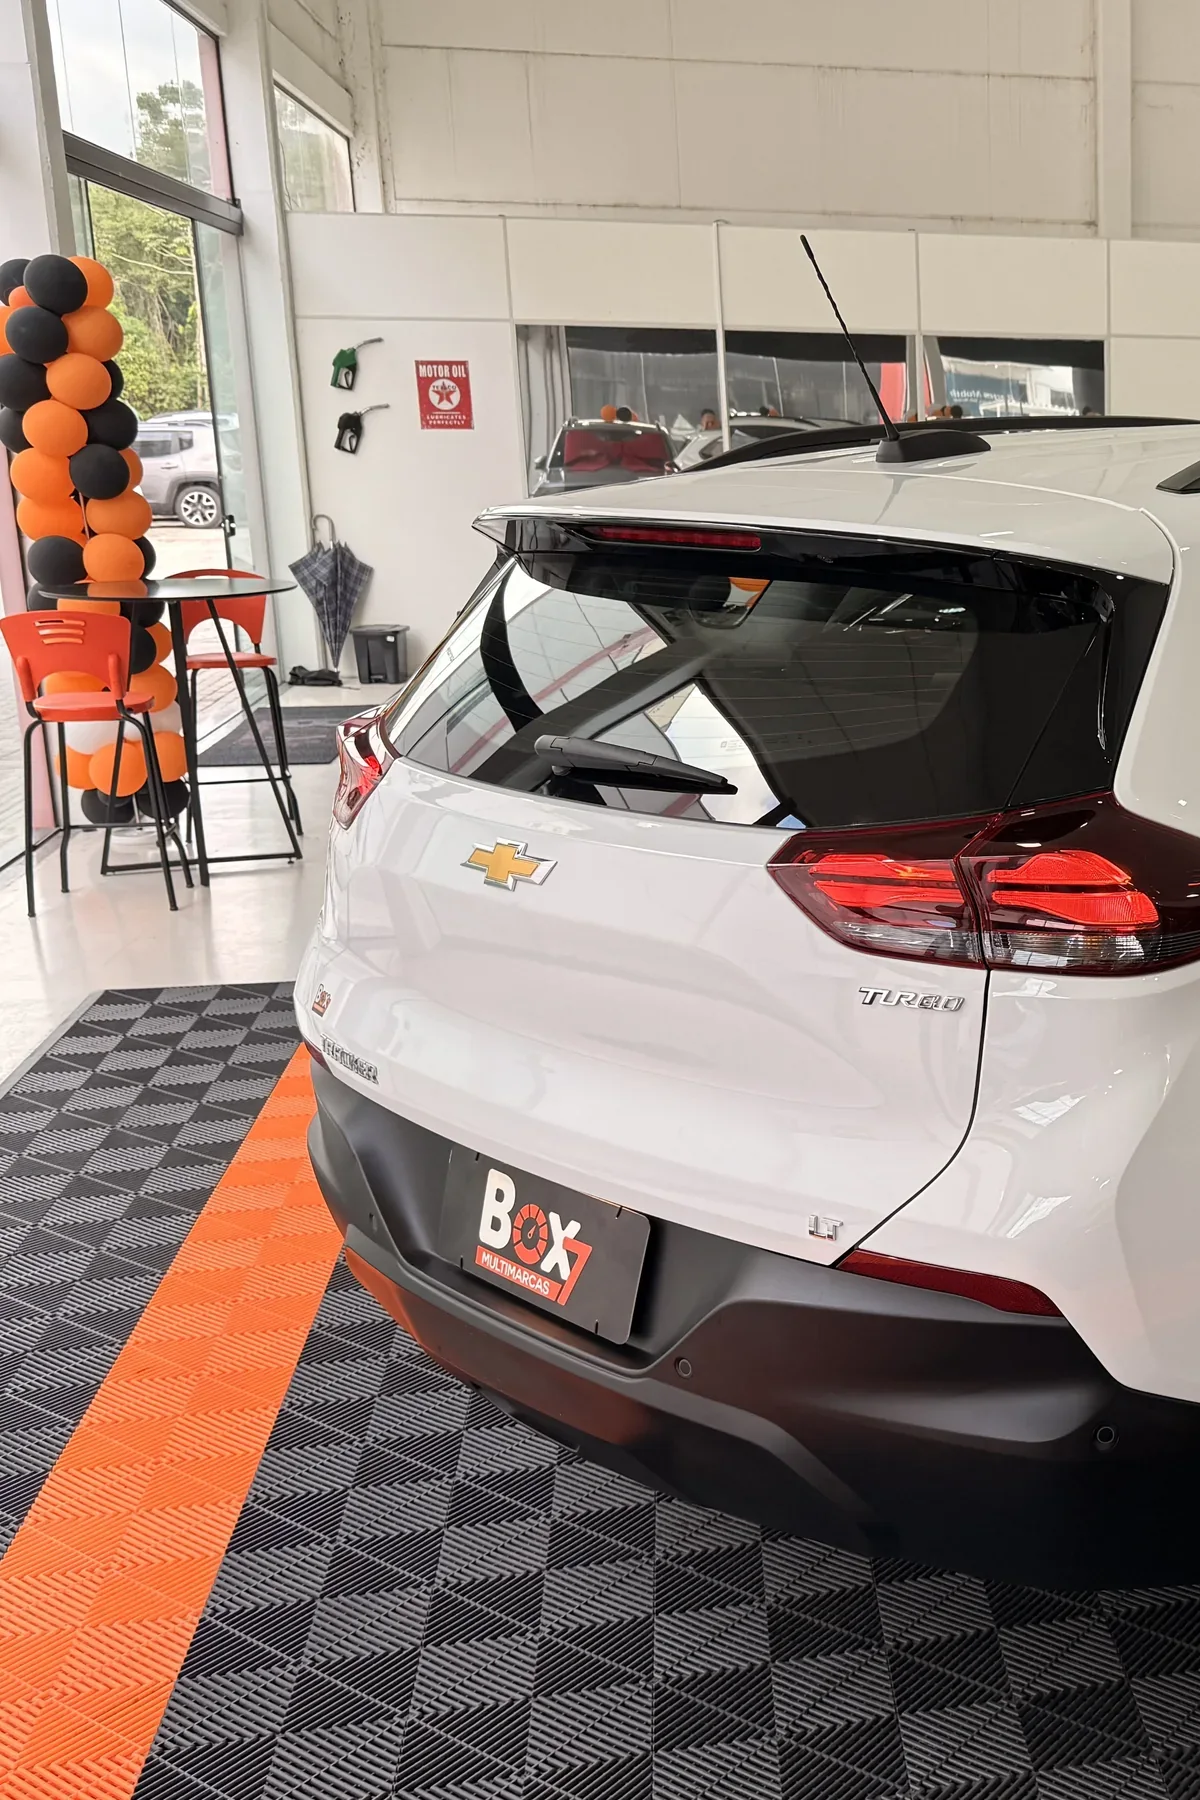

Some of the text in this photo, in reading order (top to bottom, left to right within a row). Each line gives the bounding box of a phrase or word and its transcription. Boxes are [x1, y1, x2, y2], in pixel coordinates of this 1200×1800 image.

[419, 364, 466, 378] MOTOR OIL
[859, 987, 965, 1012] TURBO
[809, 1215, 844, 1240] LT
[481, 1251, 550, 1295] MULTIMARCAS
